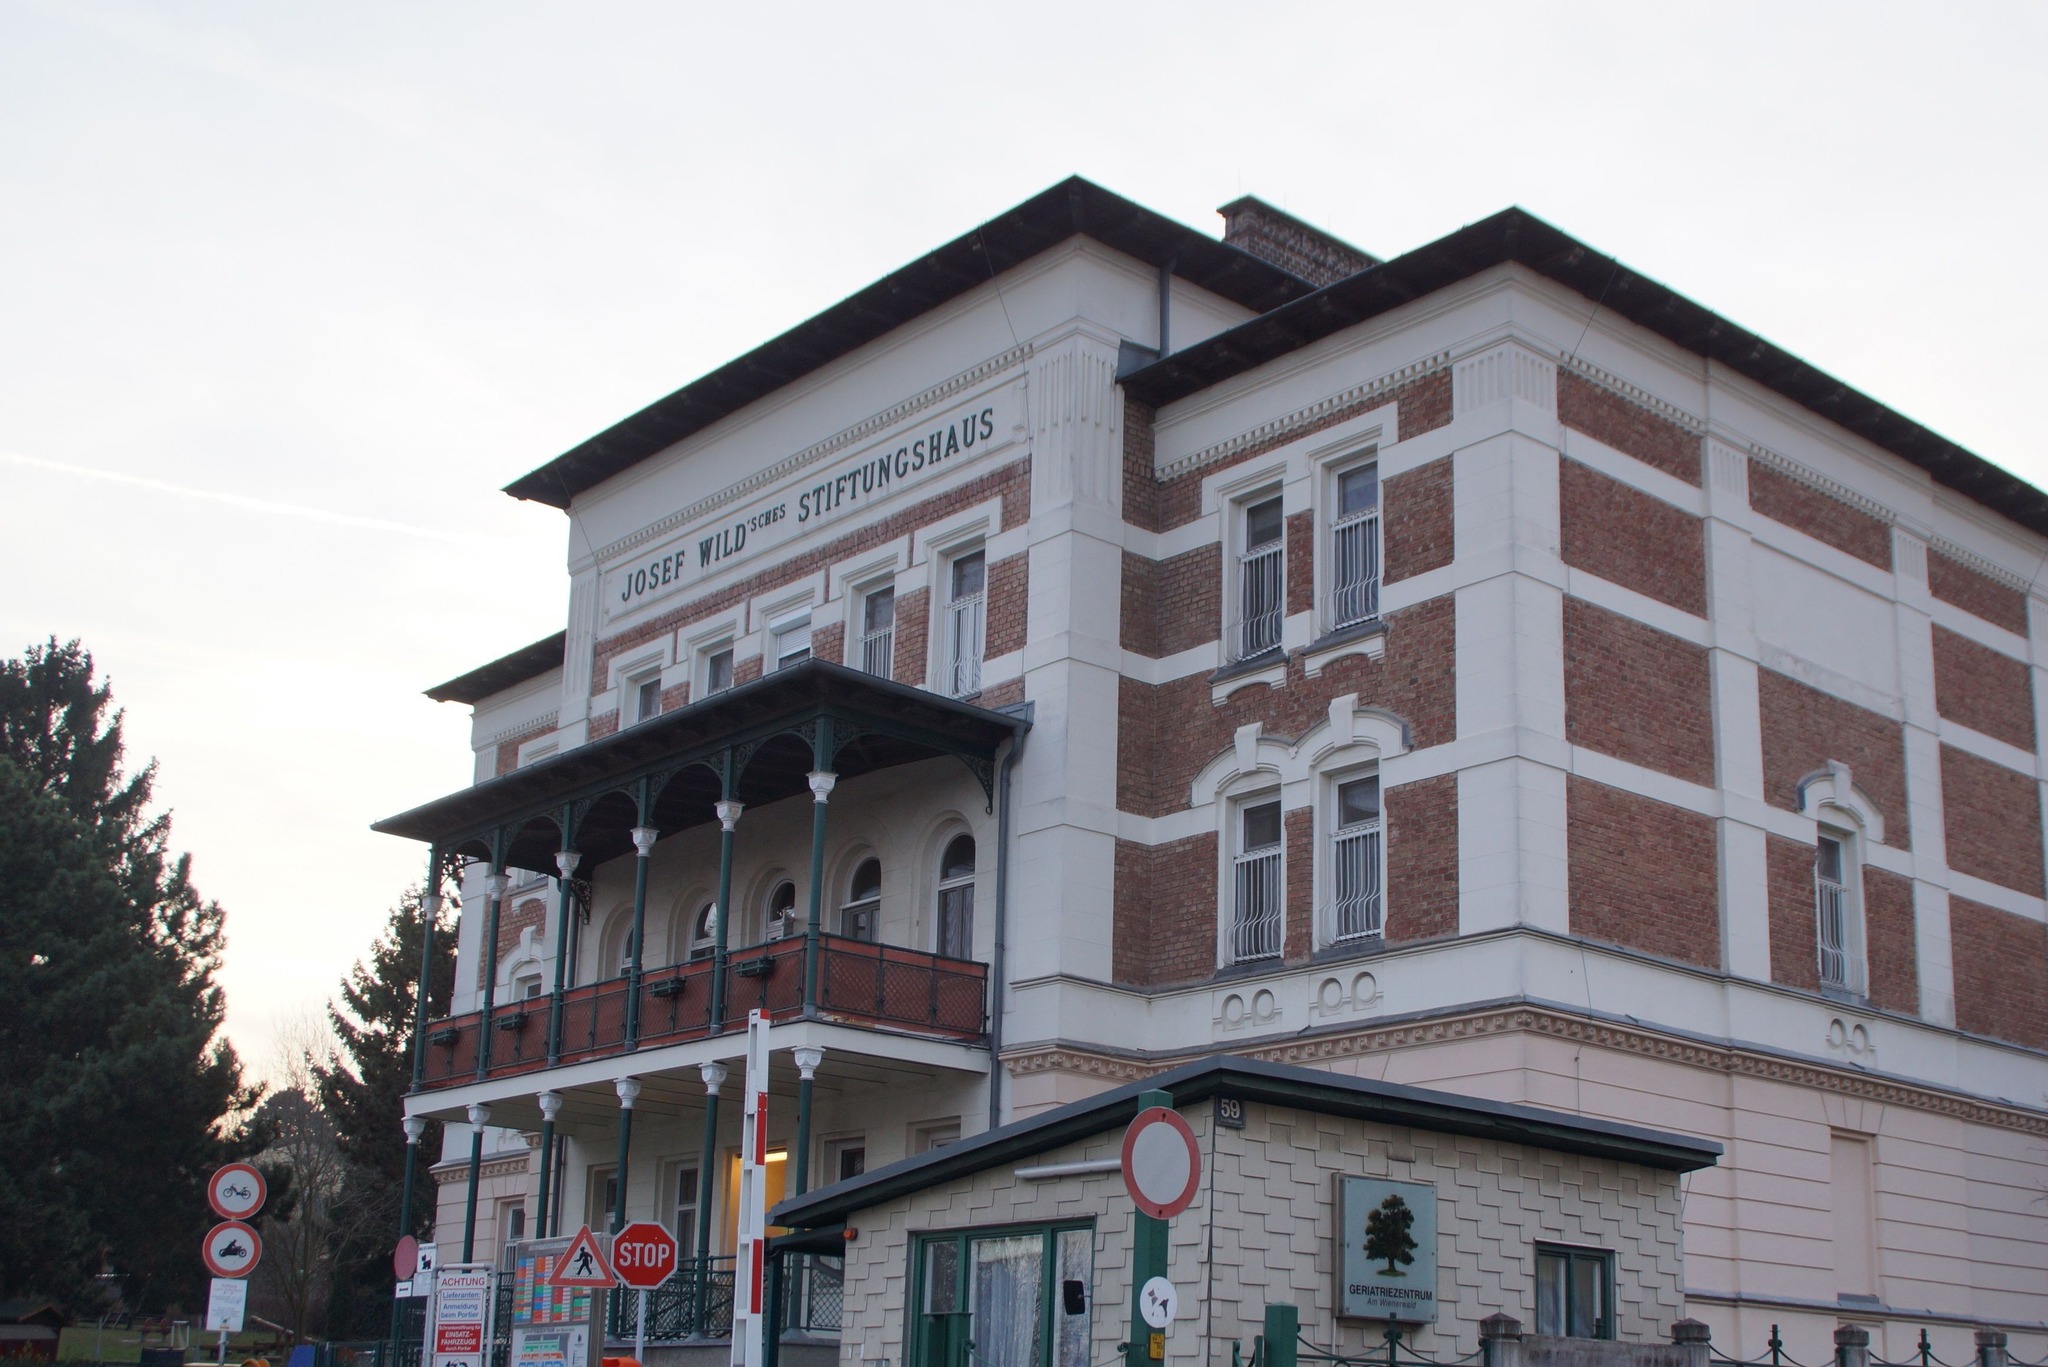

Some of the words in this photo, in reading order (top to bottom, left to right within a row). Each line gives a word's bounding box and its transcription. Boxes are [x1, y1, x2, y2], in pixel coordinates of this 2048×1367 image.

[621, 549, 686, 602] JOSEF
[798, 407, 994, 523] STIFTUNGSHAUS
[1220, 1098, 1240, 1119] 59
[619, 1241, 670, 1268] STOP
[441, 1277, 485, 1287] ACHTUNG
[442, 1291, 481, 1299] Lieferanten:
[1349, 1284, 1433, 1301] GERIATRIEZENTRUM
[443, 1303, 479, 1311] Anmeldung
[1367, 1297, 1378, 1306] Am
[1379, 1299, 1417, 1309] Wienerwald
[440, 1338, 477, 1346] FAHRZEUGE
